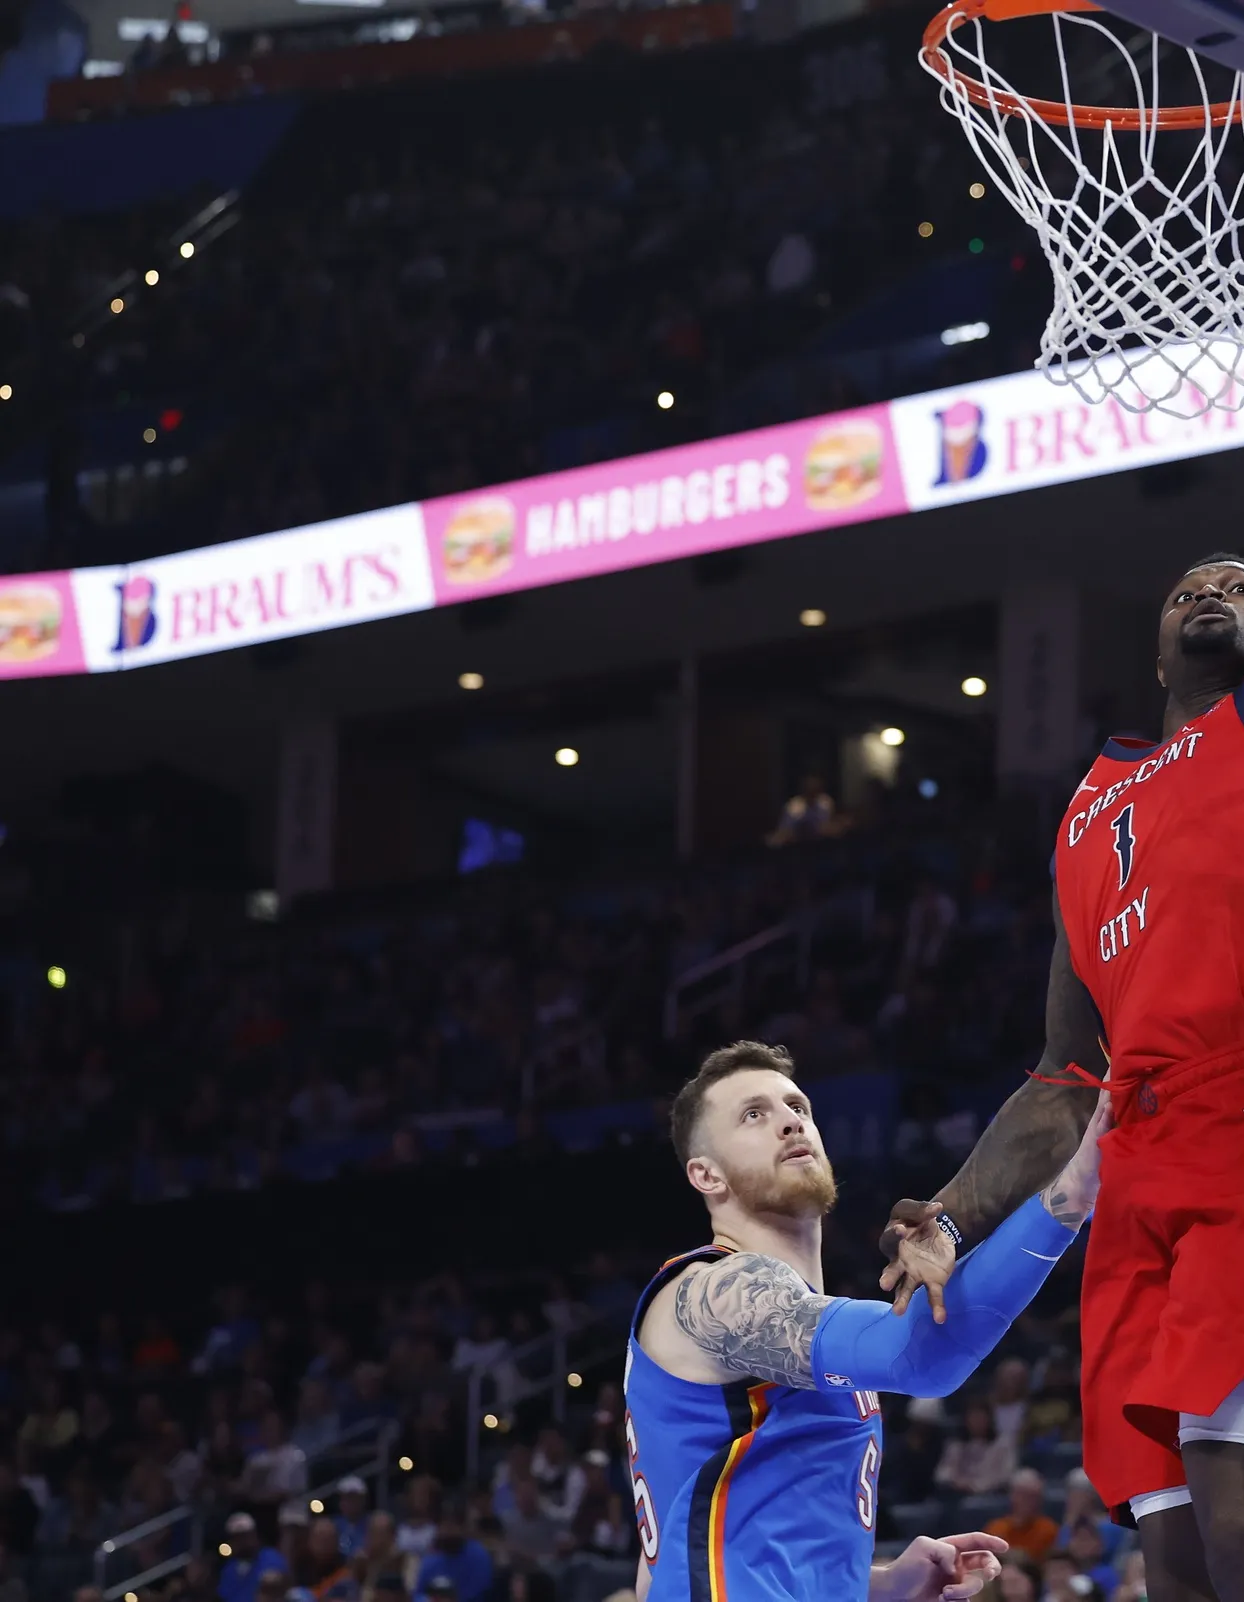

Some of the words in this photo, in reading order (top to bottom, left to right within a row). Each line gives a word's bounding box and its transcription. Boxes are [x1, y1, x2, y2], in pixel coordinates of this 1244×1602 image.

[525, 453, 790, 557] HAMBURGERS
[170, 550, 405, 643] BRAUM'S
[1068, 732, 1203, 848] CRESCENT
[1110, 802, 1136, 891] 1
[1100, 886, 1149, 963] CITY
